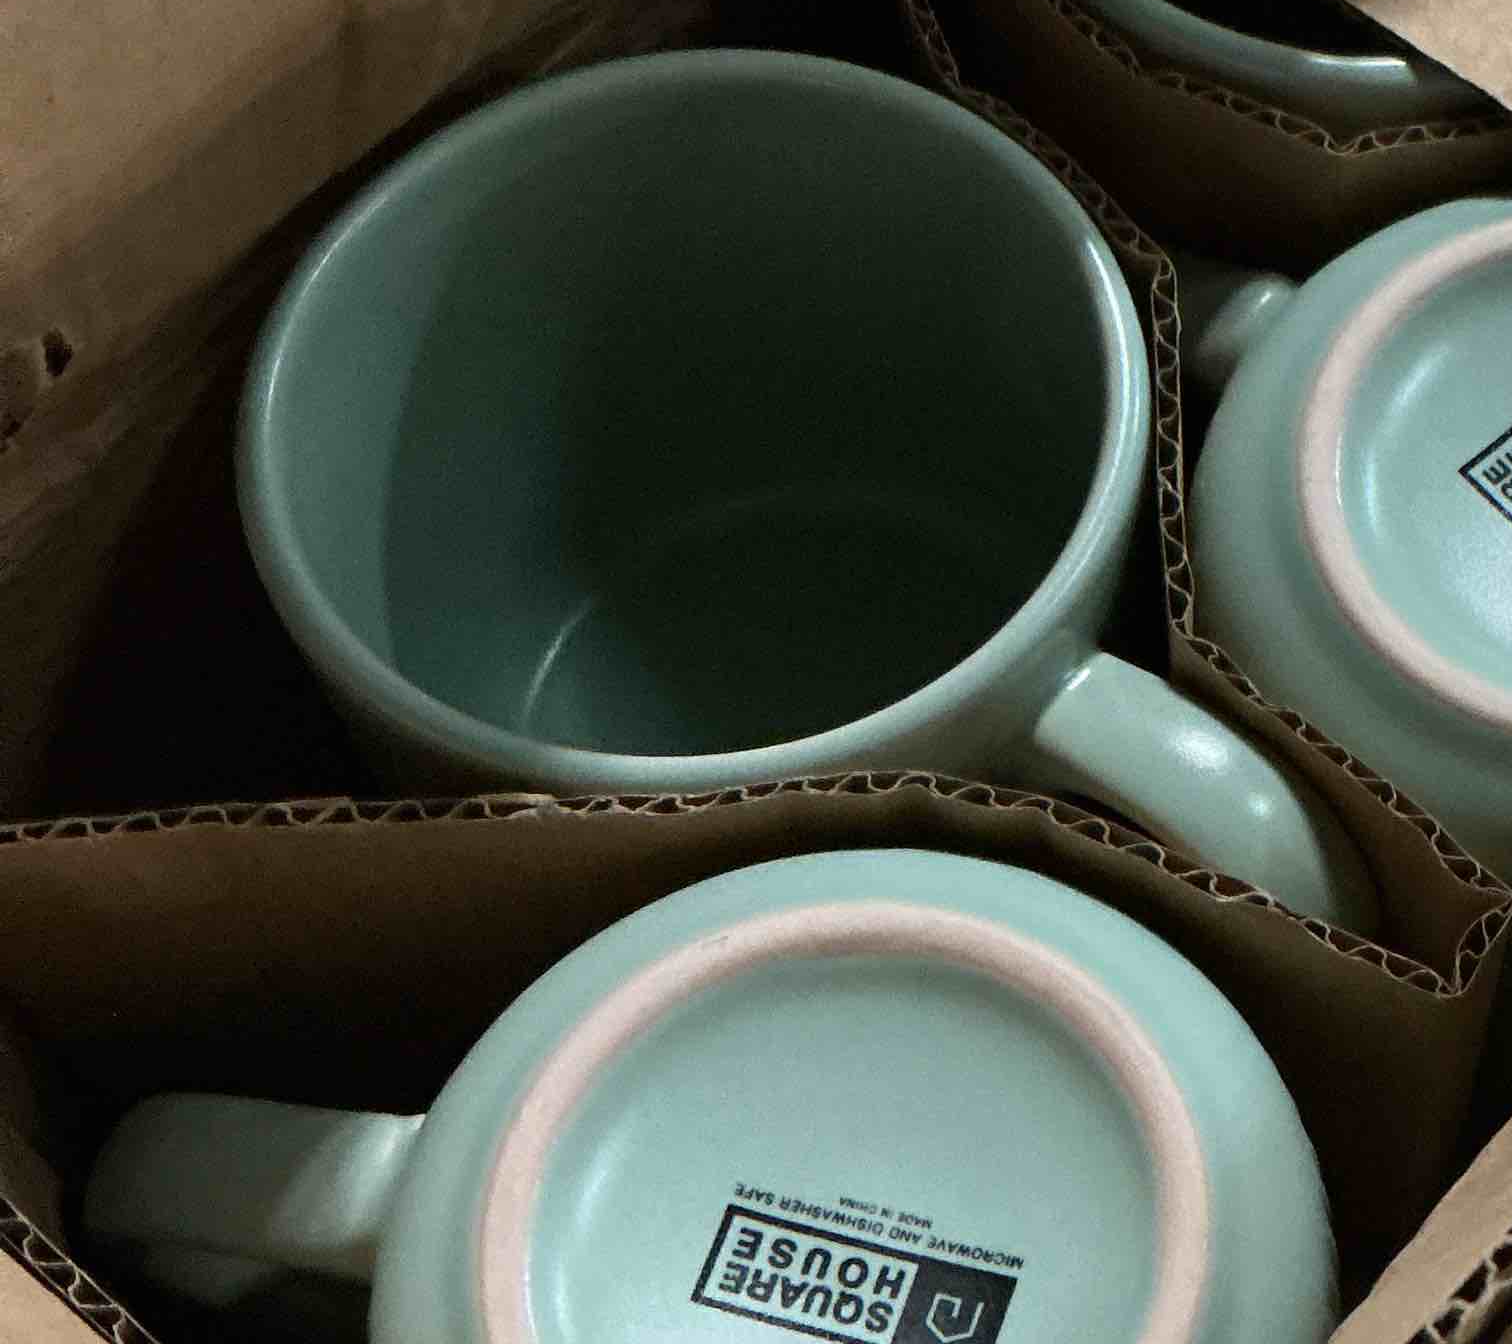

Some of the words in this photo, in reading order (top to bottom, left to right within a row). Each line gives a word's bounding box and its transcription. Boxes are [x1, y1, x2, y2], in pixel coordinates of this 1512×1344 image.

[734, 1182, 776, 1204] SAFE
[778, 1197, 882, 1238] DISHWASHER
[839, 1196, 878, 1217] CHINA
[880, 1207, 895, 1219] IN
[898, 1212, 933, 1230] MADE
[889, 1225, 922, 1246] AND
[732, 1227, 905, 1299] HOUSE
[927, 1236, 1025, 1270] MICROWAVE
[719, 1260, 894, 1334] SQUARE
